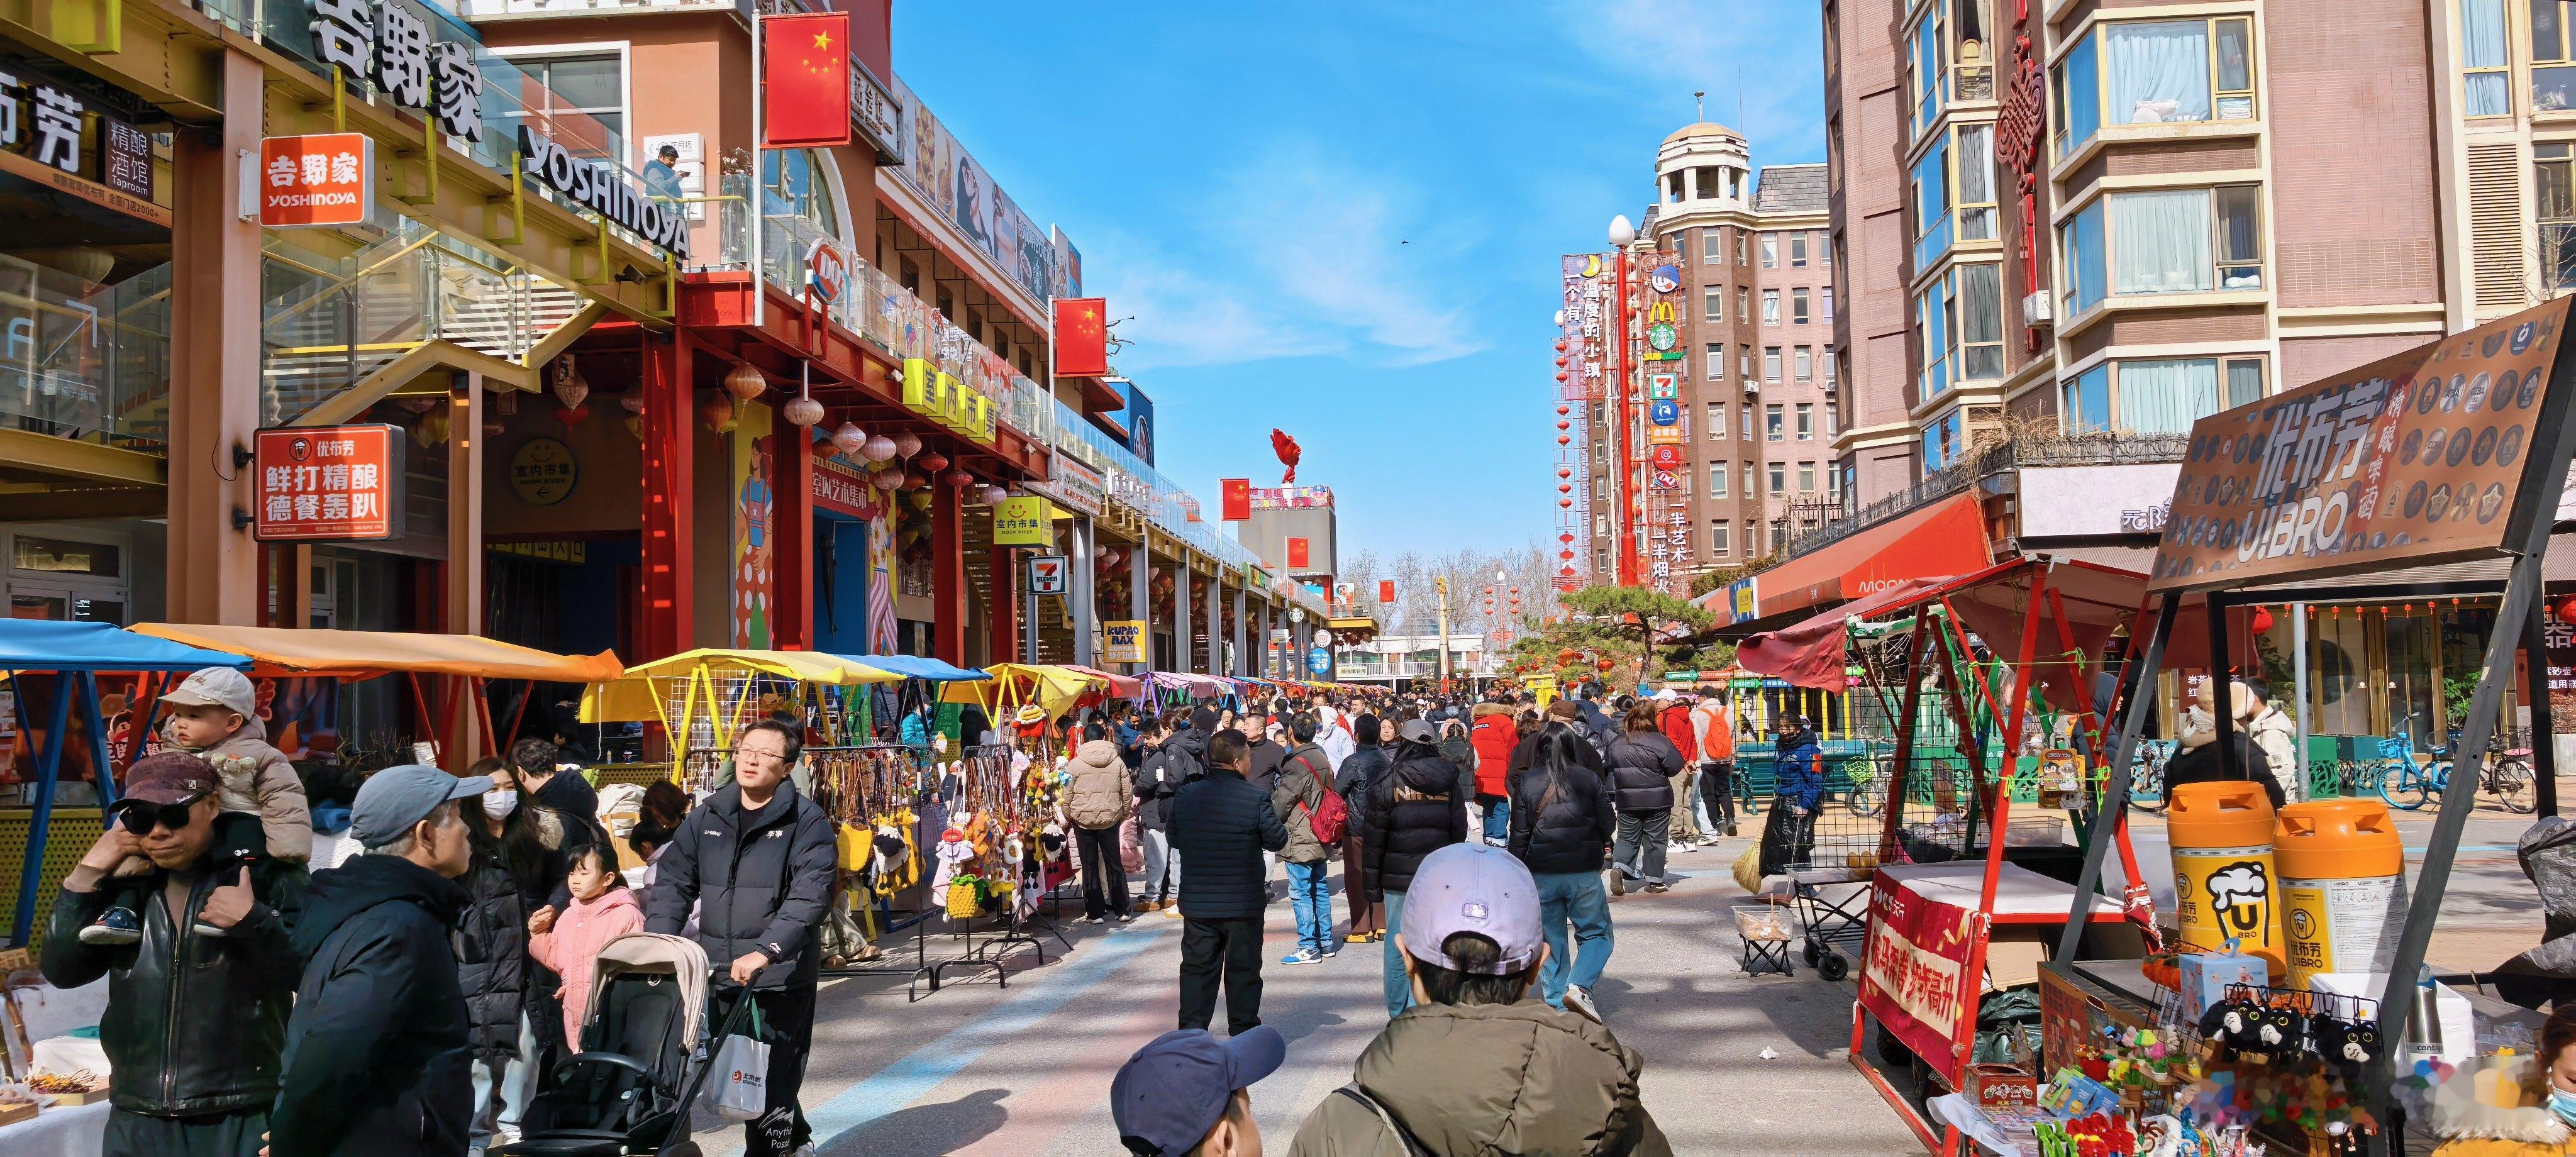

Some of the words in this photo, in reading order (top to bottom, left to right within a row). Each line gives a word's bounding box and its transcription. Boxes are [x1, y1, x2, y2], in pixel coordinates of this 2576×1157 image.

[308, 0, 483, 142] 吉野家
[111, 121, 148, 158] 精酿
[111, 148, 148, 185] 酒馆
[267, 152, 358, 187] 吉野家
[112, 174, 148, 196] Taproom
[269, 192, 357, 208] YOSHINOYA
[519, 125, 690, 260] YOSHINOYA
[109, 192, 159, 218] 全国门店2000+
[1564, 274, 1581, 322] 一个有
[1583, 282, 1601, 378] 温度的小镇
[925, 368, 995, 436] 室内市集
[317, 440, 355, 457] 优布劳
[2252, 377, 2384, 500] 优布劳
[266, 463, 378, 492] 鲜打精酿
[1658, 473, 1675, 486] DQ
[266, 492, 378, 522] 德餐轰趴
[996, 519, 1038, 529] 室内市集
[1669, 503, 1687, 563] 一半艺术
[1652, 535, 1670, 595] 一半烟火
[1108, 626, 1139, 636] KUPAO
[1111, 635, 1135, 645] MAX
[2231, 904, 2258, 930] U
[2290, 939, 2321, 957] 优布劳
